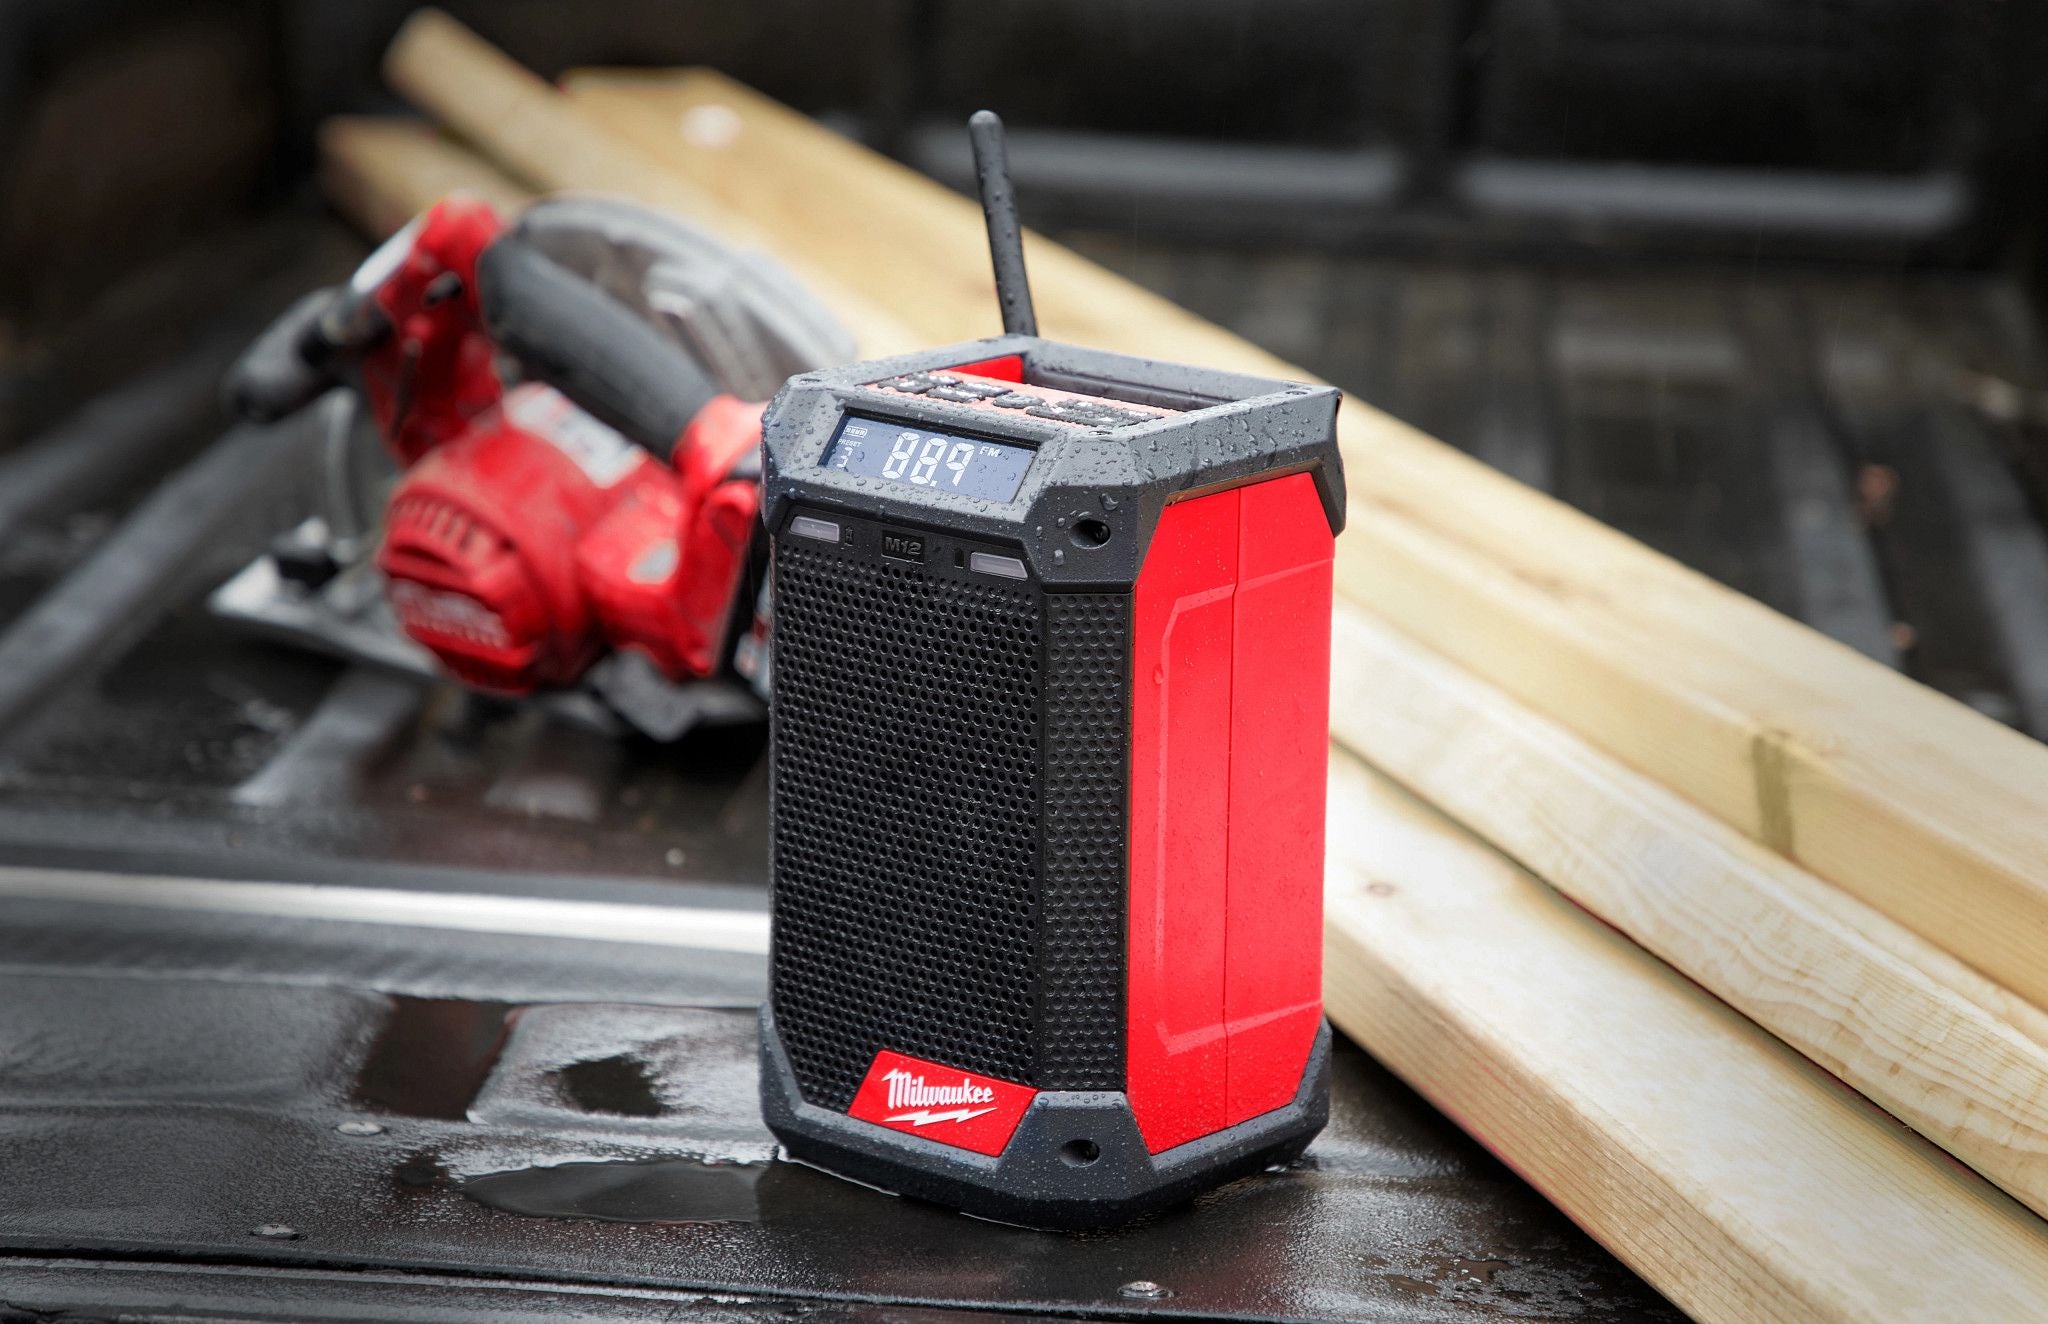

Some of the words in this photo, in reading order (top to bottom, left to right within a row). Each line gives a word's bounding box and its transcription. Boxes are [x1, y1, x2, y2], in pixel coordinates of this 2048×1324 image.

[837, 438, 863, 448] PRESET
[837, 446, 853, 468] 3
[881, 431, 975, 487] 88.9
[979, 445, 1001, 457] FM
[885, 536, 922, 555] M12
[881, 1068, 995, 1110] Milwaukee
